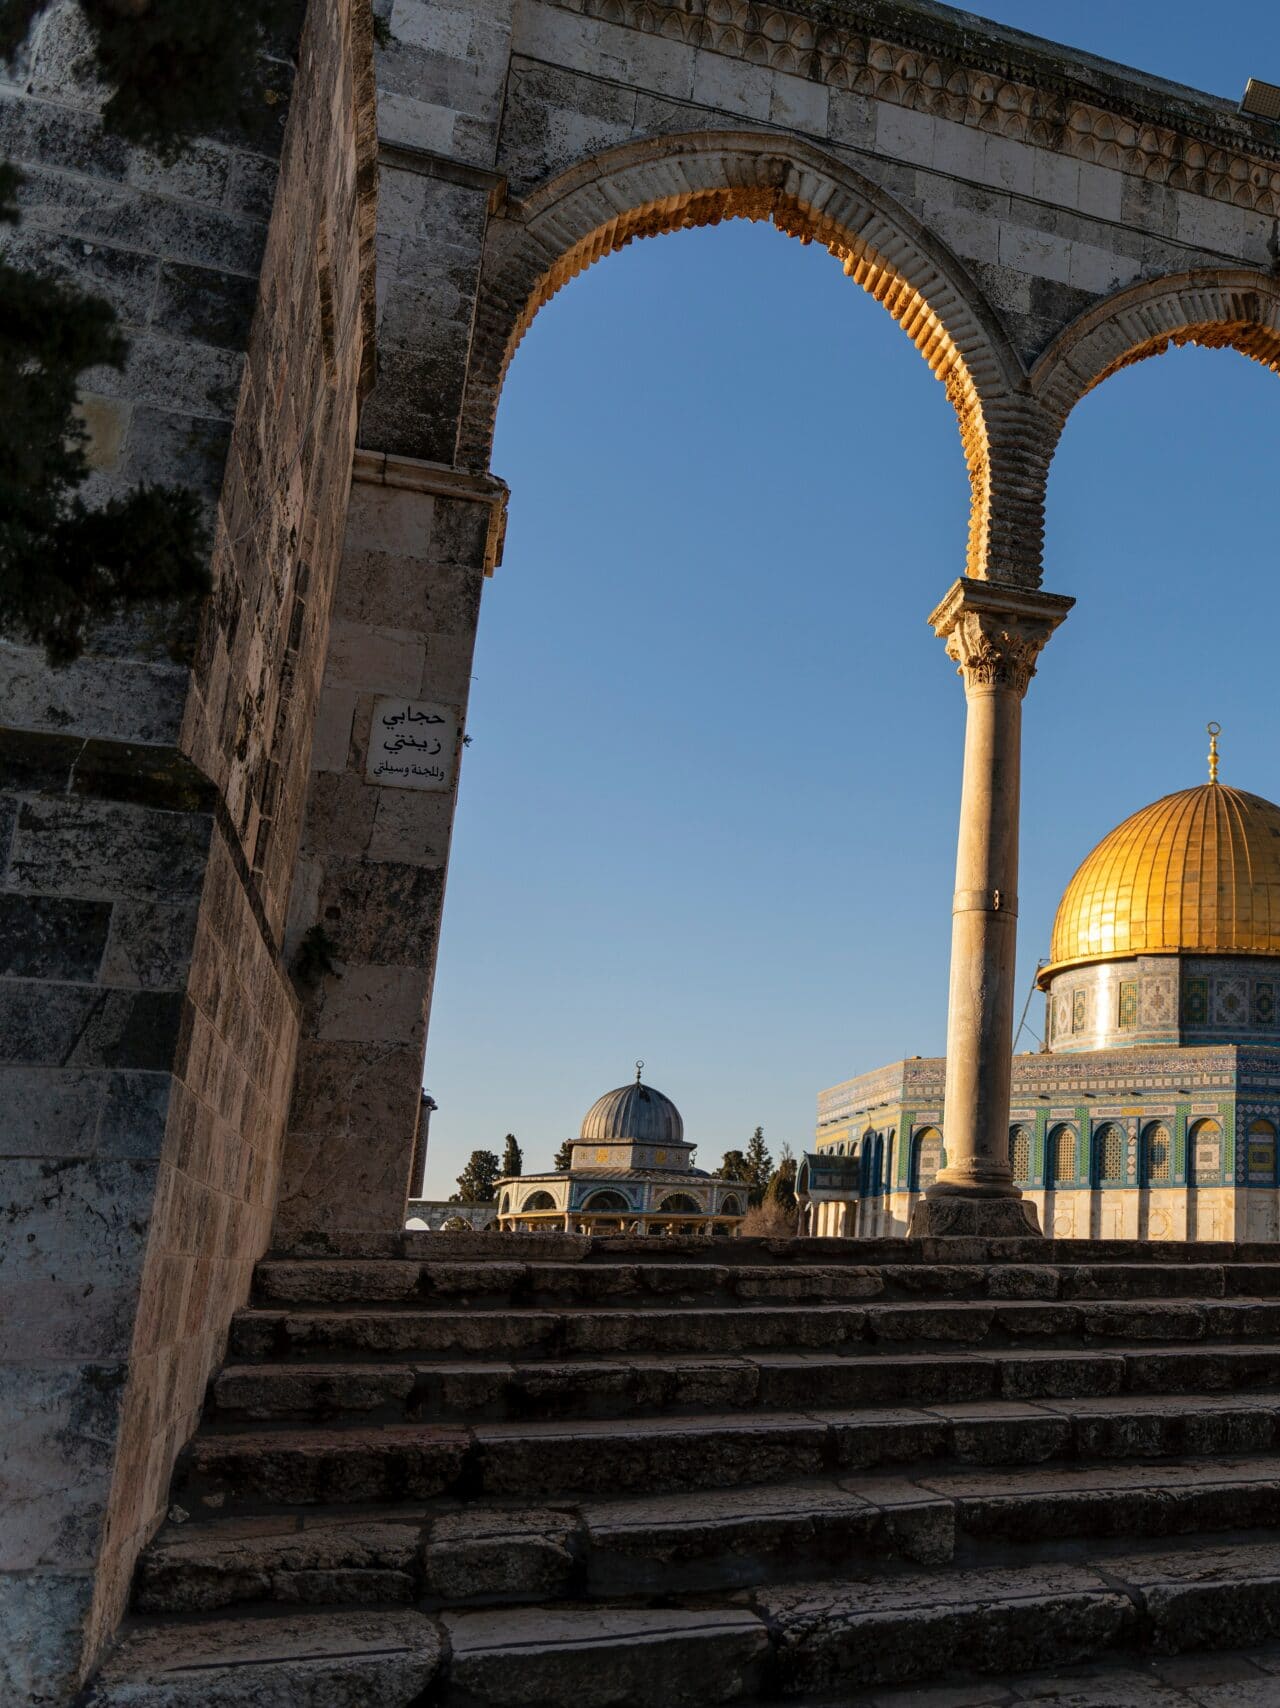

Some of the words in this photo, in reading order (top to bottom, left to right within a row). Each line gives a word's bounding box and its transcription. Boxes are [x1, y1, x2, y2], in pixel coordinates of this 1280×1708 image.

[382, 705, 446, 730] حجابي
[383, 734, 442, 755] زينتي
[373, 760, 410, 777] وسيلتي
[411, 763, 445, 781] وللجنة
